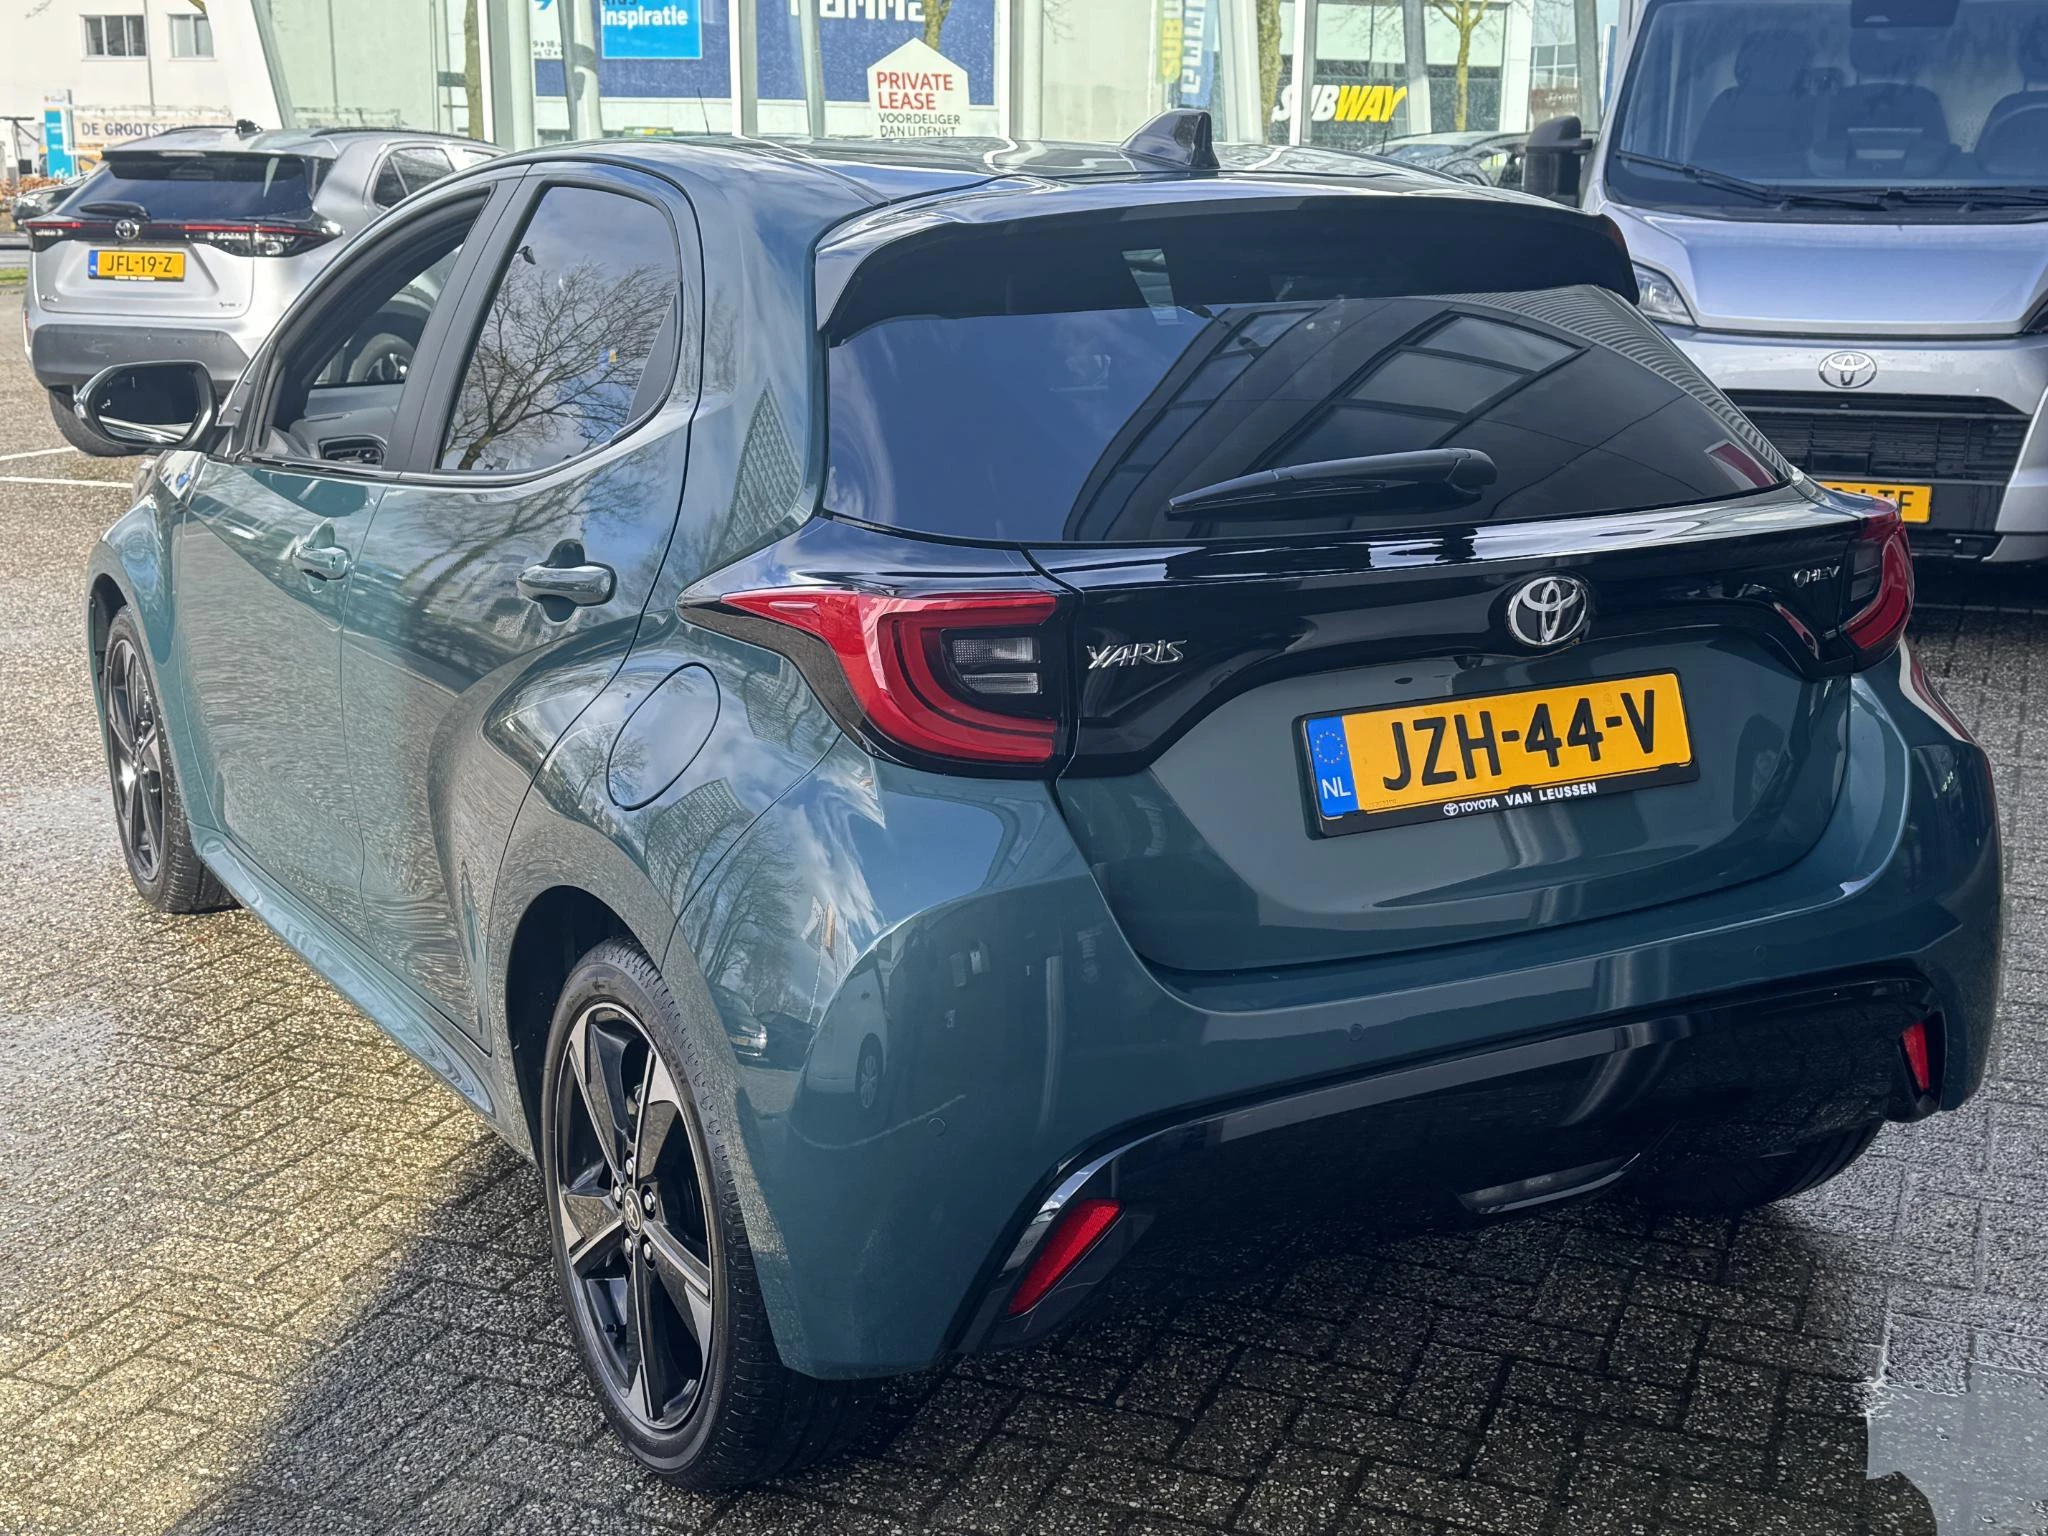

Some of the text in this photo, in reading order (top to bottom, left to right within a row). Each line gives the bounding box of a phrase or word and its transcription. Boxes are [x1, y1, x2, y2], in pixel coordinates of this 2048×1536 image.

[601, 5, 688, 30] inspiratie
[877, 72, 954, 91] PRIVATE
[878, 92, 936, 110] LEASE
[1271, 85, 1408, 122] SBWAY
[82, 122, 100, 136] DE
[878, 113, 961, 125] VOORDELIGER
[880, 125, 905, 137] DAN
[908, 126, 916, 137] U
[107, 255, 173, 273] JFL-19-Z
[1086, 640, 1187, 669] YARIS
[1382, 689, 1655, 791] JZH-44-V
[1322, 776, 1351, 800] NL
[1459, 782, 1598, 813] TOYOTA VAN LEUSSEN
